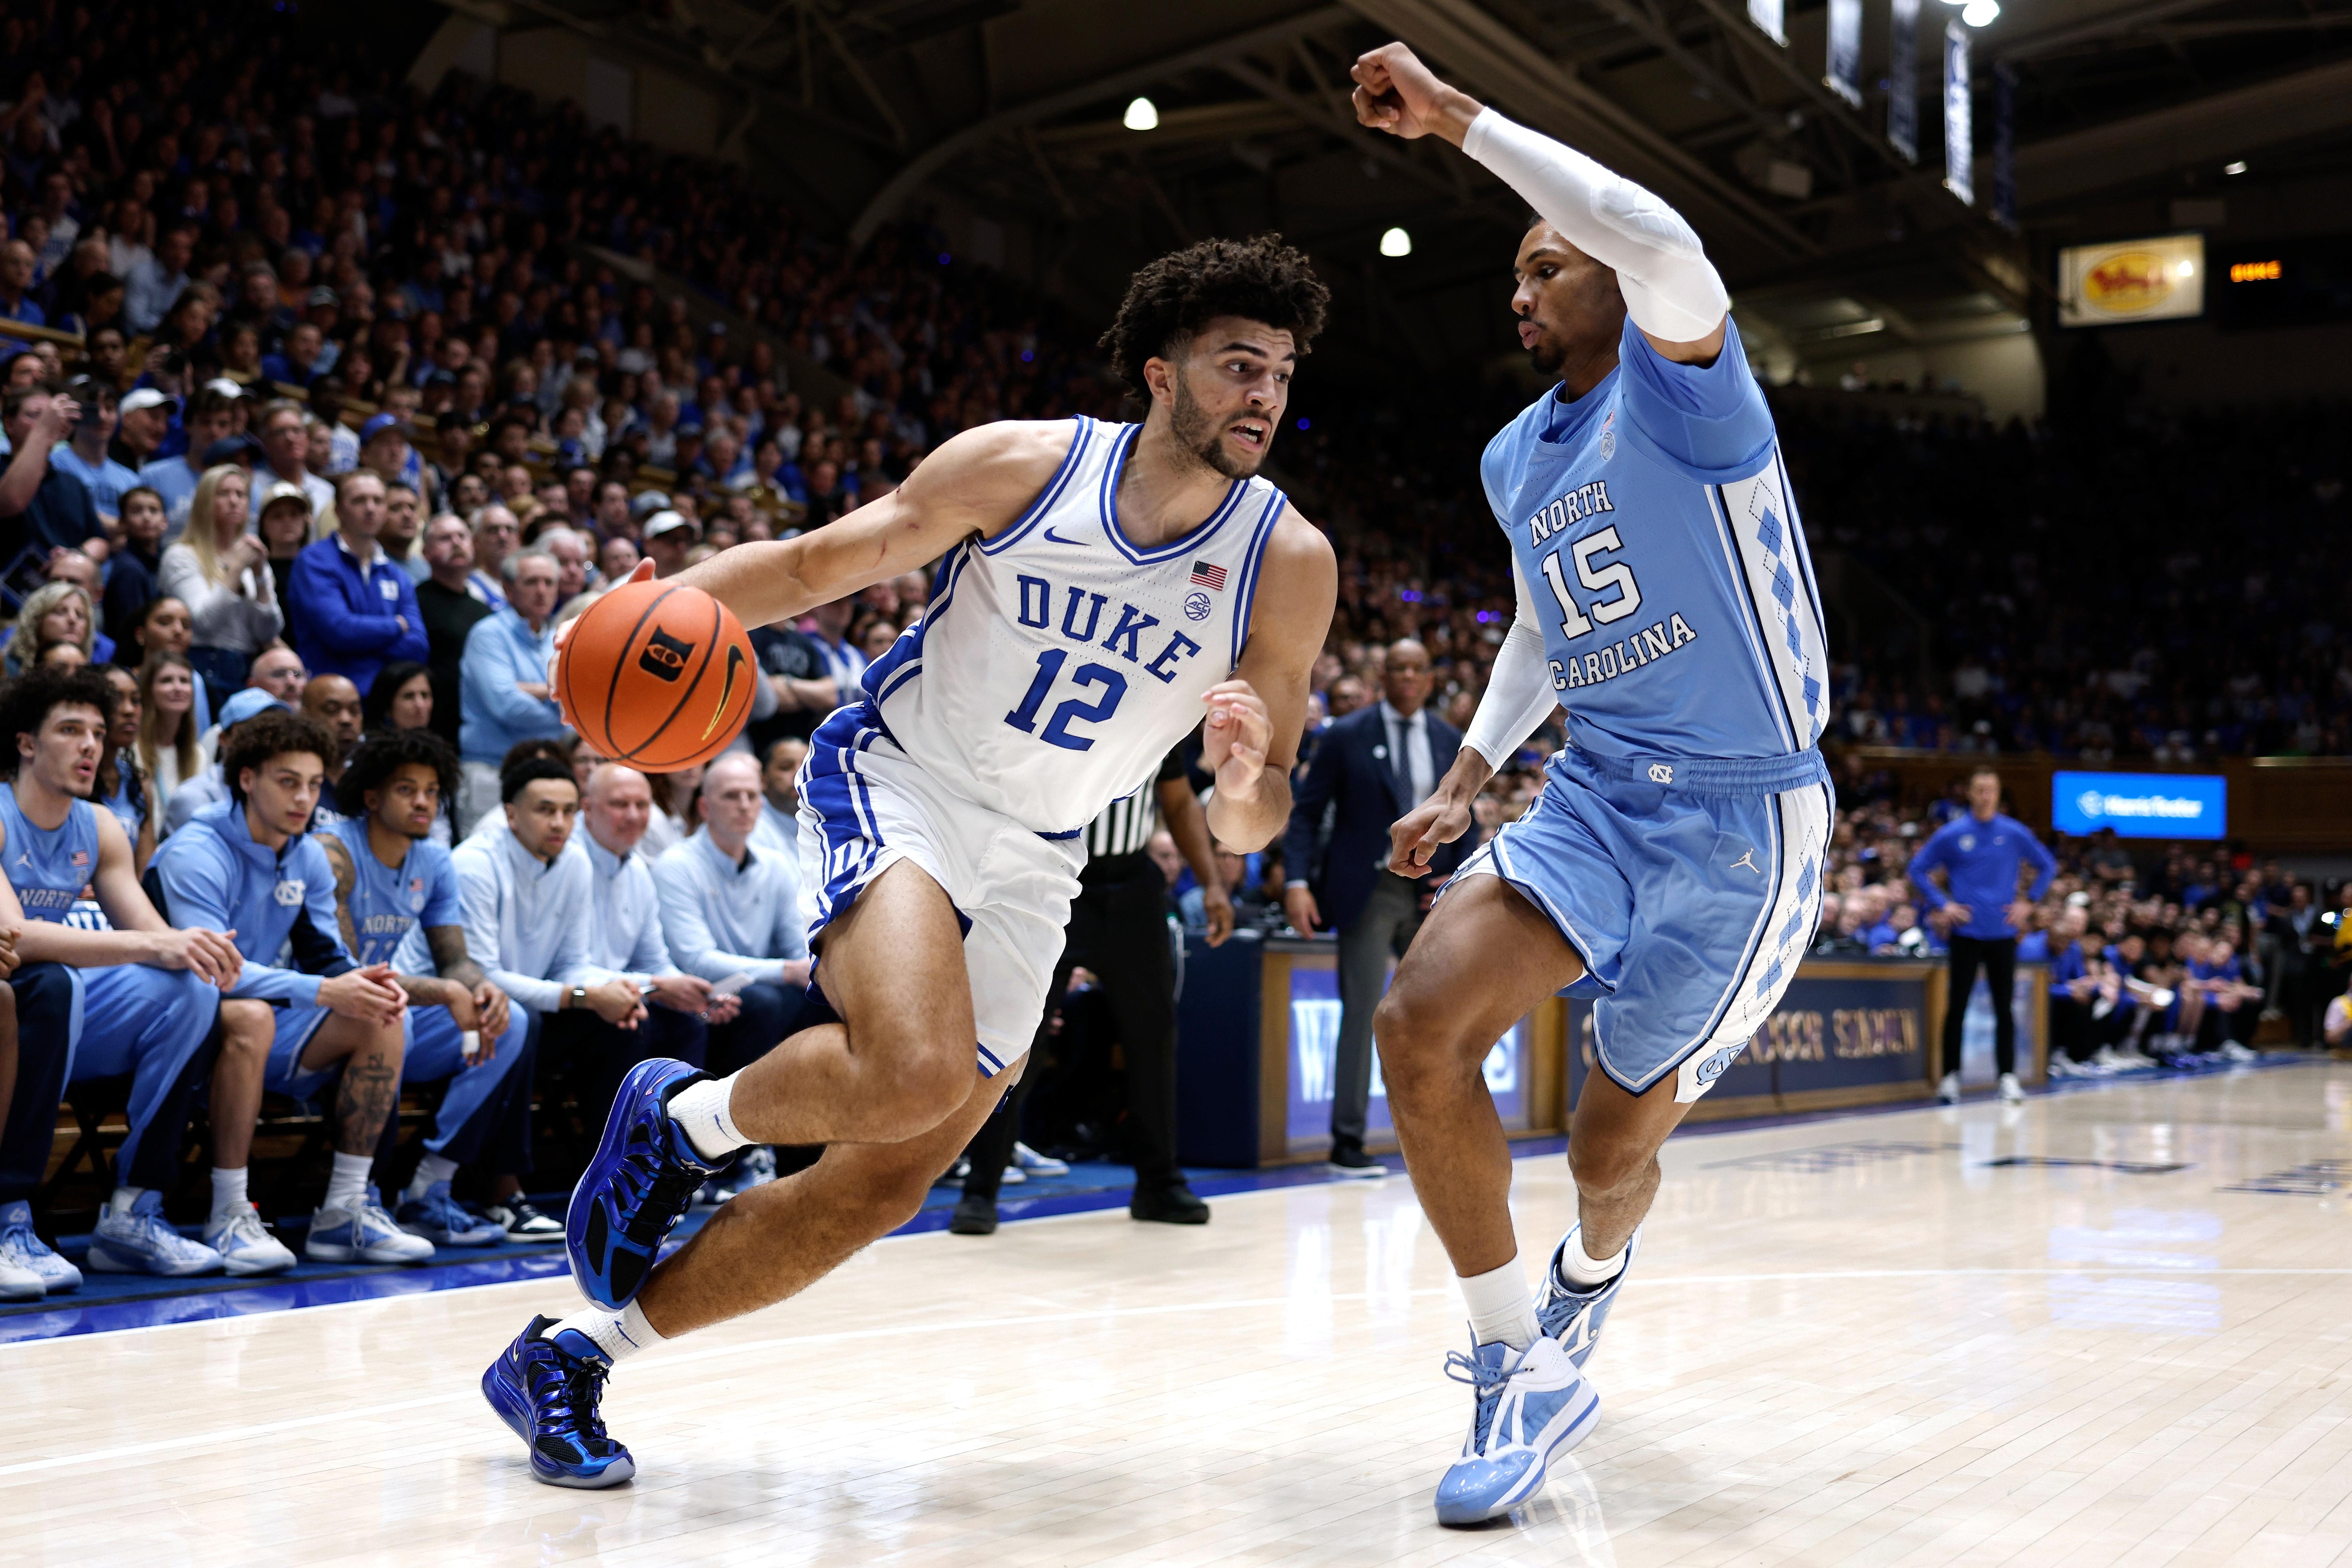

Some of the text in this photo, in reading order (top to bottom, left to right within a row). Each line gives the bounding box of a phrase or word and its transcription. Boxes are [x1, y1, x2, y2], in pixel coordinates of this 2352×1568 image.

[1529, 480, 1613, 549] NORTH
[1188, 601, 1209, 613] ACC
[1542, 525, 1643, 641] 15
[1017, 574, 1201, 684] DUKE
[1549, 612, 1697, 691] CAROLINA
[1004, 648, 1128, 751] 12
